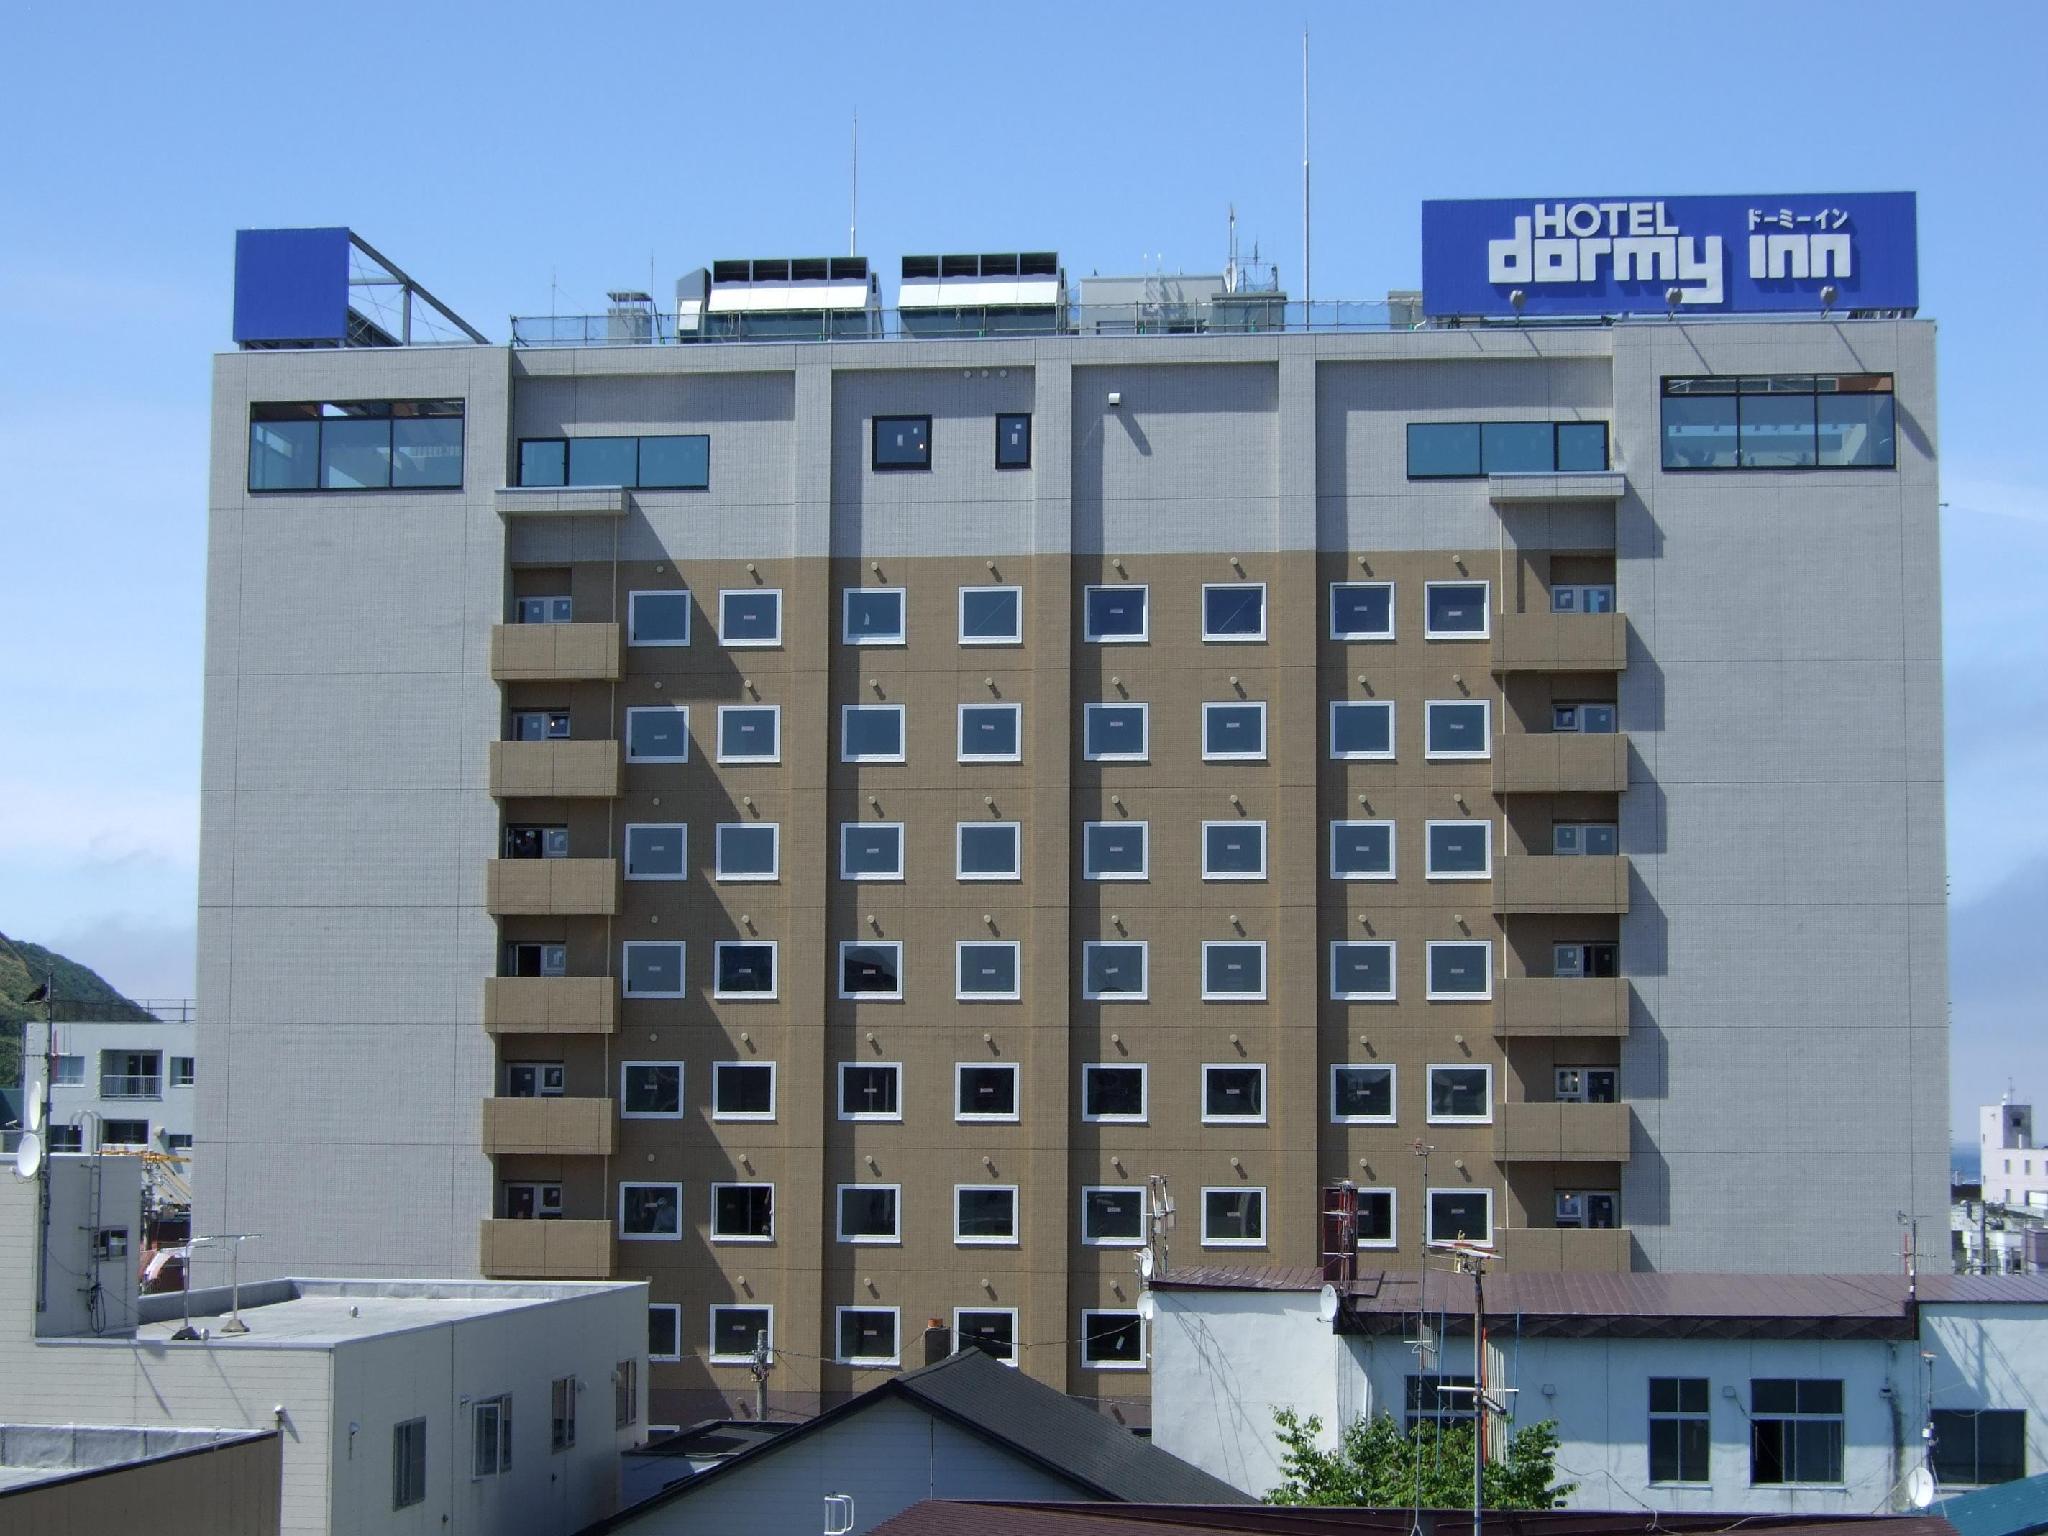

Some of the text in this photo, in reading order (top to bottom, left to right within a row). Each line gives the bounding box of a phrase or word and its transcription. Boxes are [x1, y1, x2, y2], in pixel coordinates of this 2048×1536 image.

[1535, 201, 1679, 237] HOTEL
[1748, 209, 1849, 231] ドーミーイン
[1488, 216, 1851, 304] dormy inn
